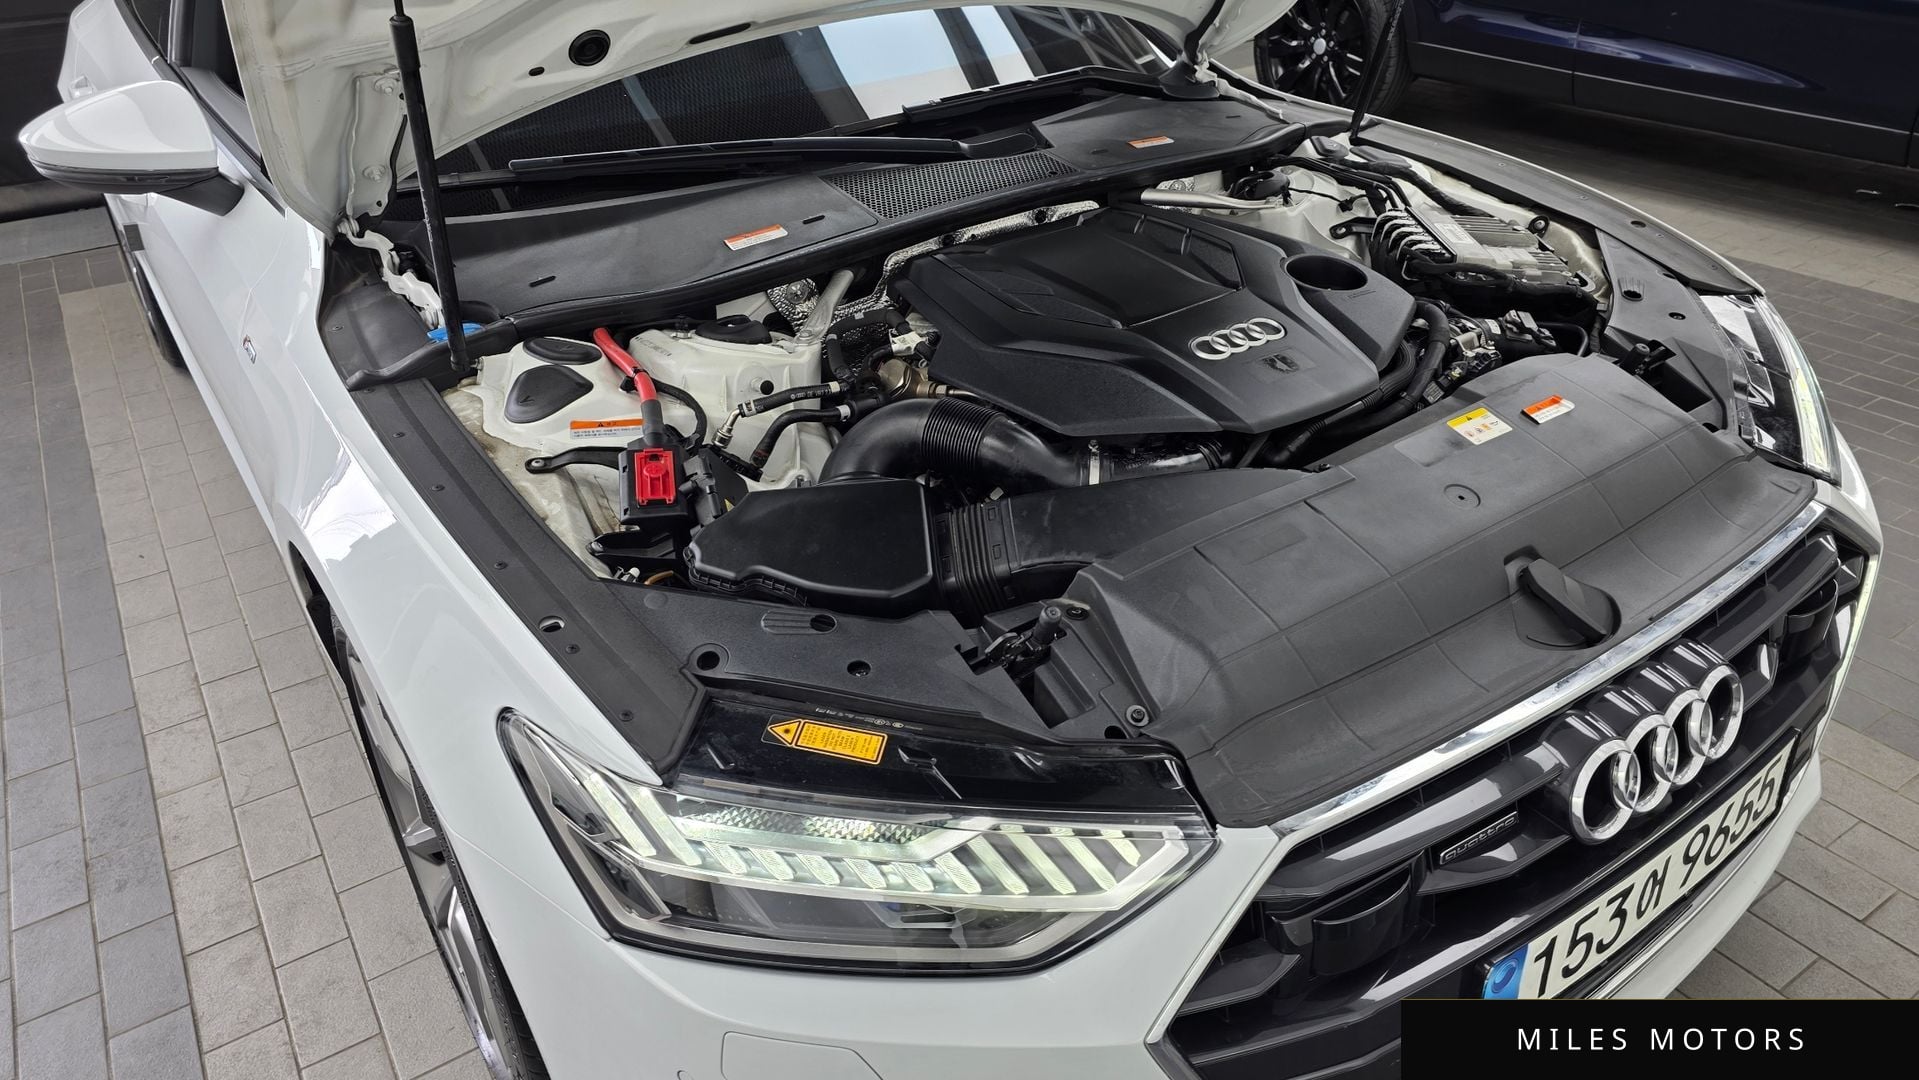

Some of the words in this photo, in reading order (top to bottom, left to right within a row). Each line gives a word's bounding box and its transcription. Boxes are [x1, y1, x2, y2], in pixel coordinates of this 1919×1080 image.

[1444, 816, 1517, 861] quattro
[1533, 855, 1672, 998] 153어
[1679, 757, 1784, 889] 9655
